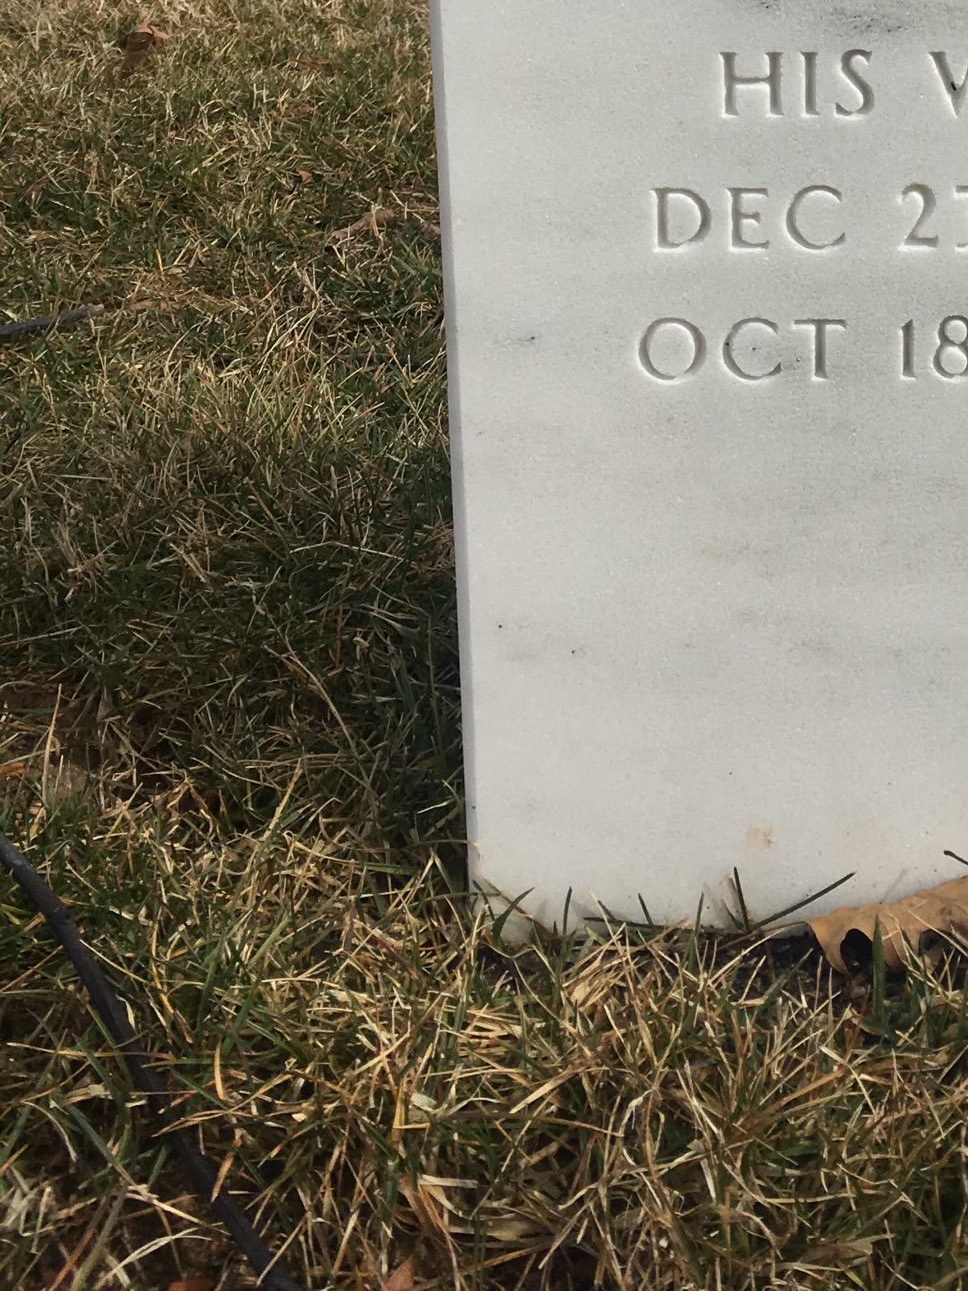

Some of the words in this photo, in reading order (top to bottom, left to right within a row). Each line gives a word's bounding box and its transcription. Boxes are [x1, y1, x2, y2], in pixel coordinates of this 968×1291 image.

[718, 48, 876, 119] HIS
[649, 184, 847, 252] DEC
[637, 316, 847, 381] OCT
